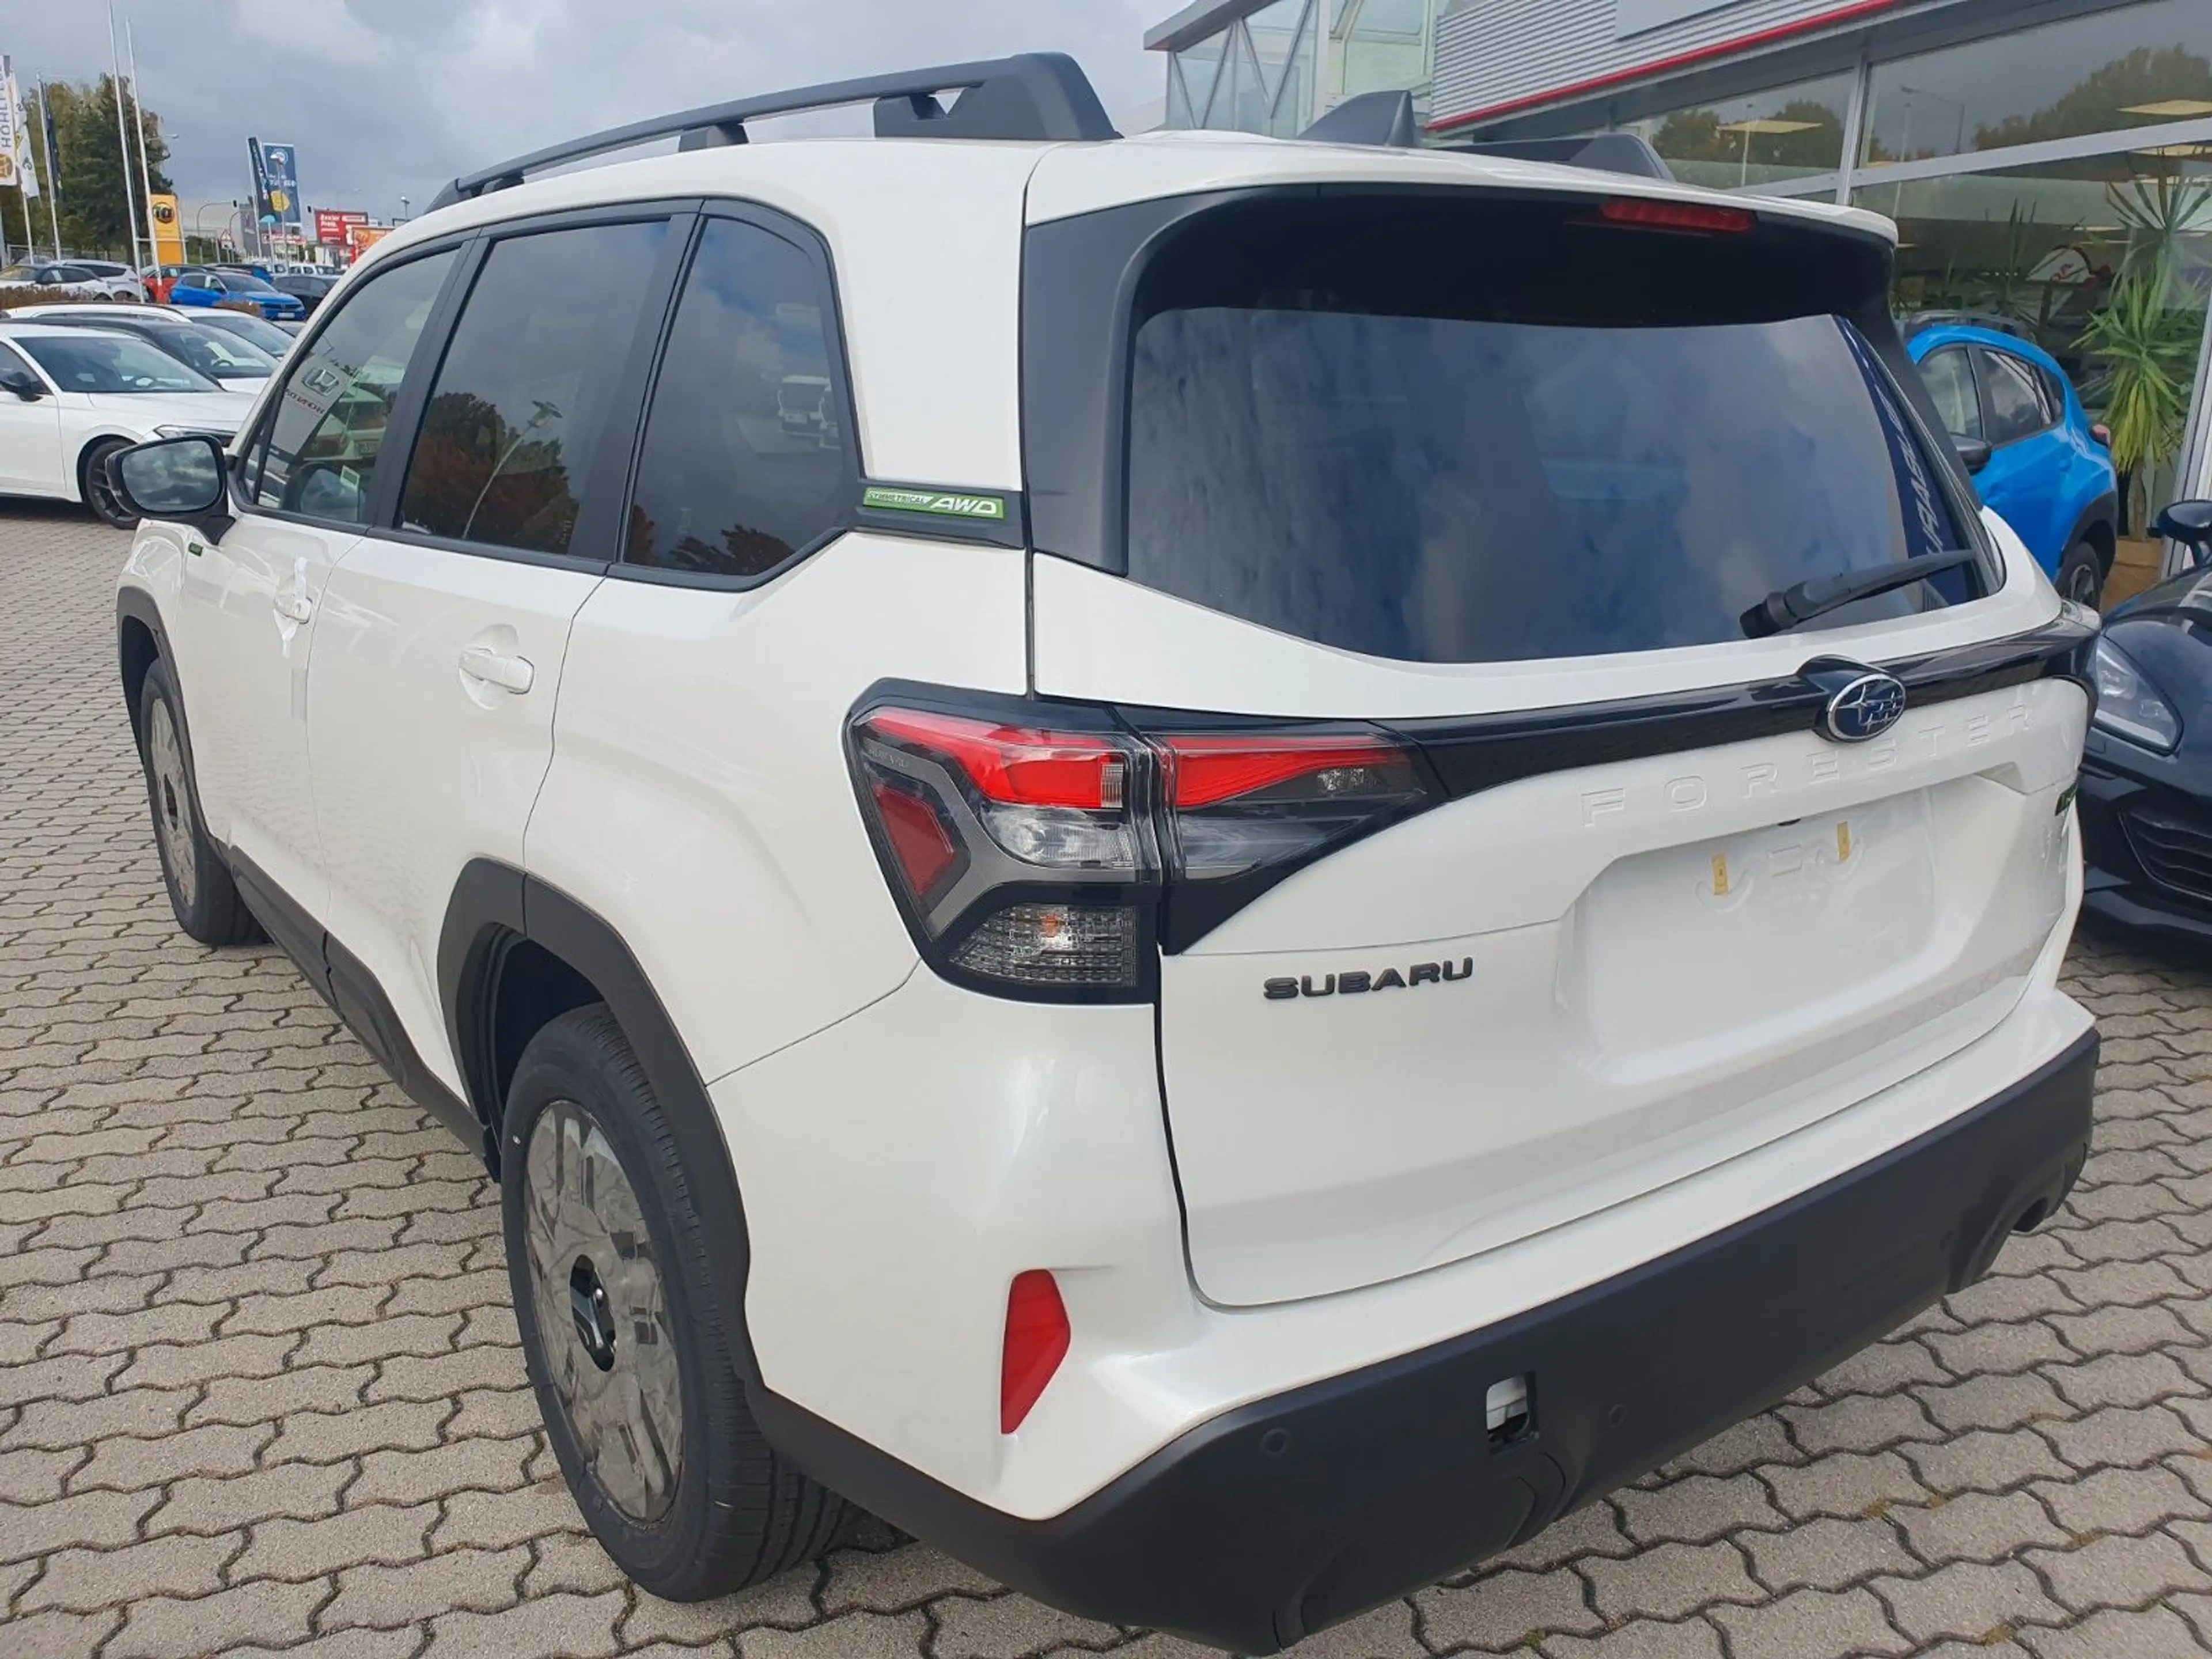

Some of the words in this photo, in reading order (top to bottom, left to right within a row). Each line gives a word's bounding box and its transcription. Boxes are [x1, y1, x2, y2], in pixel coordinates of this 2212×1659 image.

[929, 497, 997, 514] AWD
[1581, 703, 2037, 828] FORESTER
[1263, 957, 1474, 999] SUBARU
